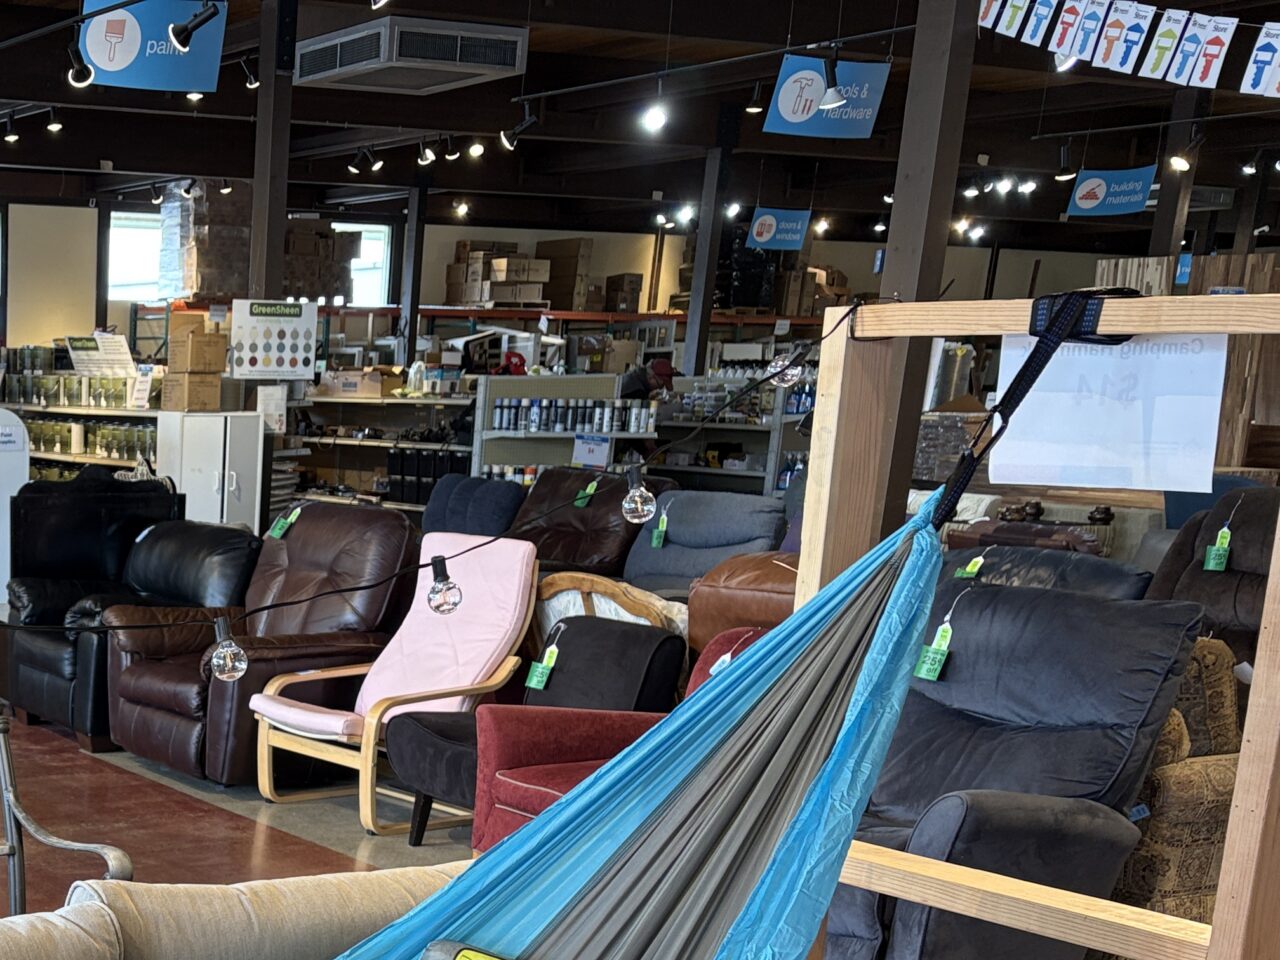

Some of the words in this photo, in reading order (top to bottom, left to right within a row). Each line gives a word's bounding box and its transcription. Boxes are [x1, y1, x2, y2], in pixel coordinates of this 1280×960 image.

[860, 84, 869, 98] &
[1110, 181, 1143, 192] building
[1105, 193, 1144, 205] materials
[251, 304, 300, 315] GreenSheen
